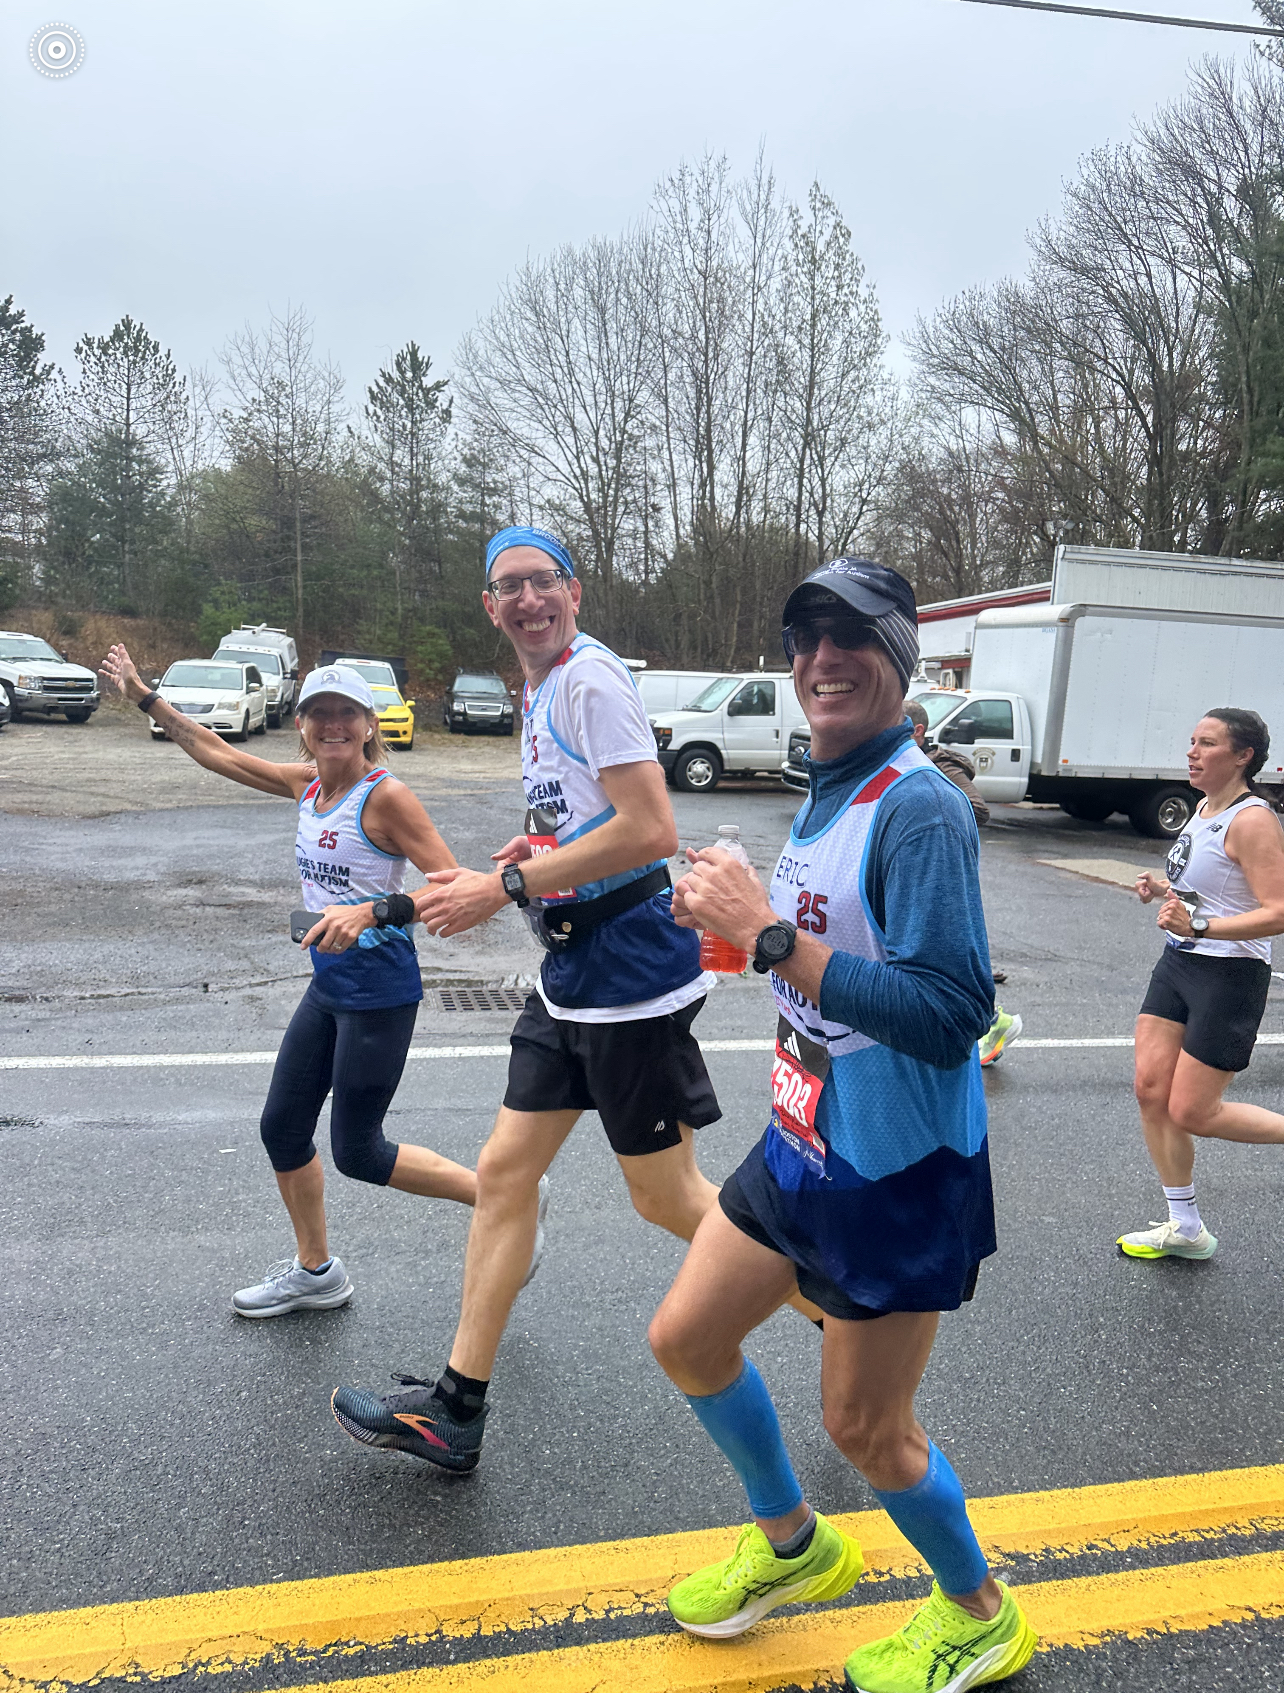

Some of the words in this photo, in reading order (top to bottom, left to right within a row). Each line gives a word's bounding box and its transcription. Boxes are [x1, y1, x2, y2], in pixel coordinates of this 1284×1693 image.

[532, 528, 565, 551] BROOKS
[318, 829, 339, 850] 25
[317, 861, 350, 877] TEAM
[776, 855, 809, 887] ERIC
[796, 890, 828, 935] 25
